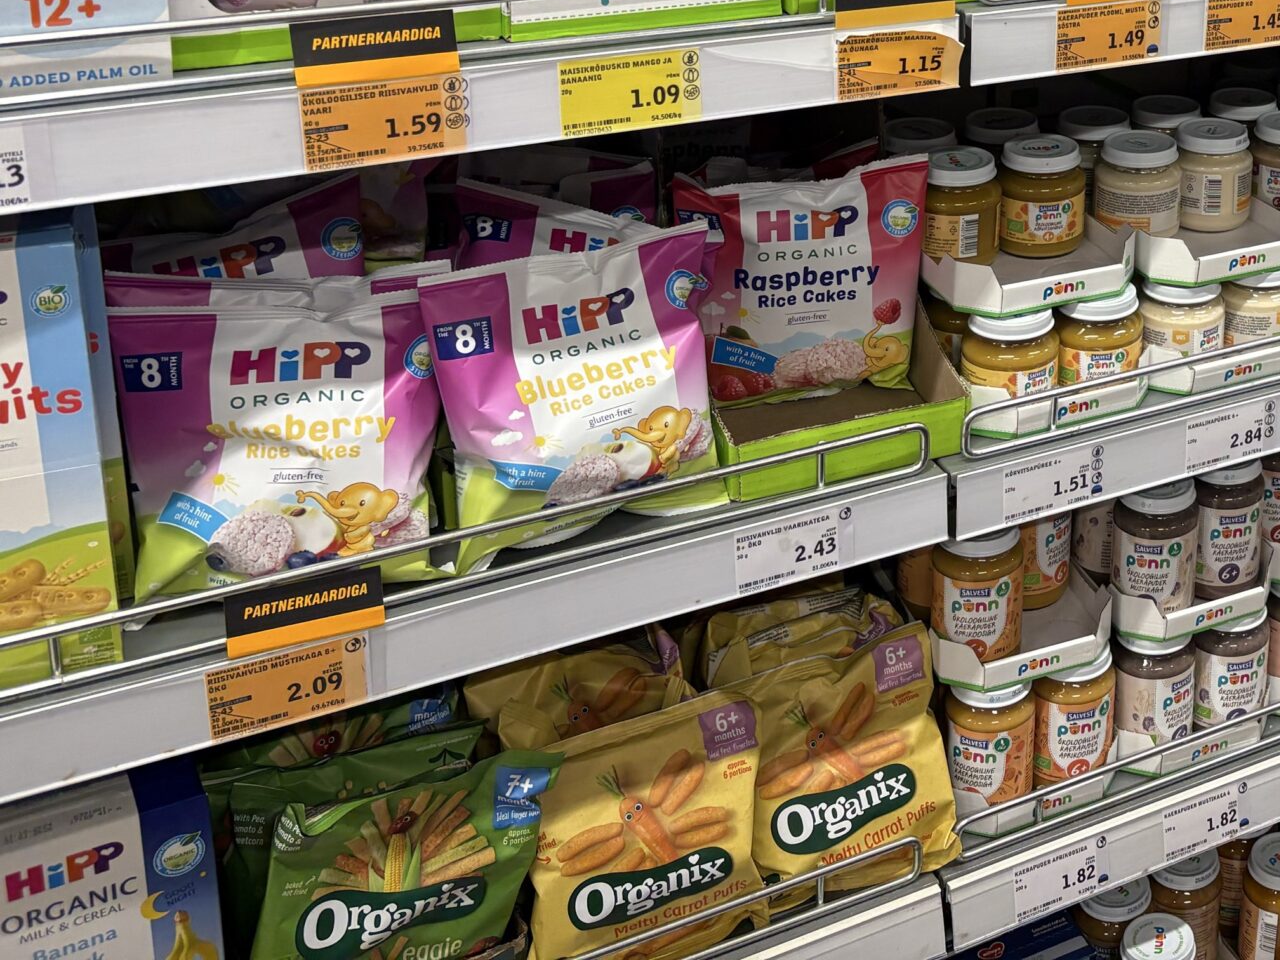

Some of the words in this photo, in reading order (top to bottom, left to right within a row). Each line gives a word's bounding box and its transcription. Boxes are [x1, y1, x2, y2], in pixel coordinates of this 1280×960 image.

[312, 26, 441, 50] PARTNERKAARDIGA
[1108, 30, 1144, 49] 1.49
[10, 72, 71, 87] ADDED
[77, 66, 123, 81] PALM
[129, 64, 158, 77] OIL
[631, 84, 680, 109] 1.09
[385, 113, 442, 138] 1.59
[756, 206, 858, 244] HiPP
[757, 244, 857, 262] ORGANIC
[733, 264, 880, 289] Raspberry
[758, 292, 796, 308] Rice
[802, 287, 856, 304] Cakes
[522, 287, 635, 345] HiPP
[788, 311, 827, 323] gluten-free
[533, 329, 642, 366] ORGANIC
[230, 341, 370, 386] HiPP
[516, 345, 676, 405] Blueberry
[230, 390, 366, 410] ORGANIC
[550, 394, 592, 416] Rice
[598, 373, 656, 405] Cakes
[1230, 427, 1262, 448] 2.84
[1054, 474, 1089, 495] 1.51
[794, 538, 837, 563] 2.43
[244, 582, 369, 620] PARTNERKAARDIGA
[883, 660, 913, 675] months
[885, 646, 907, 665] 6+
[207, 666, 269, 685] RIISIVAHVLID
[287, 673, 343, 703] 2.09
[776, 771, 910, 848] Organix
[864, 815, 906, 849] Carrot
[906, 801, 938, 828] Puffs
[5, 842, 125, 900] HiPP
[1062, 865, 1096, 889] 1.82
[576, 852, 729, 930] Organix
[1, 875, 138, 934] ORGANIC
[304, 881, 476, 952] Organix
